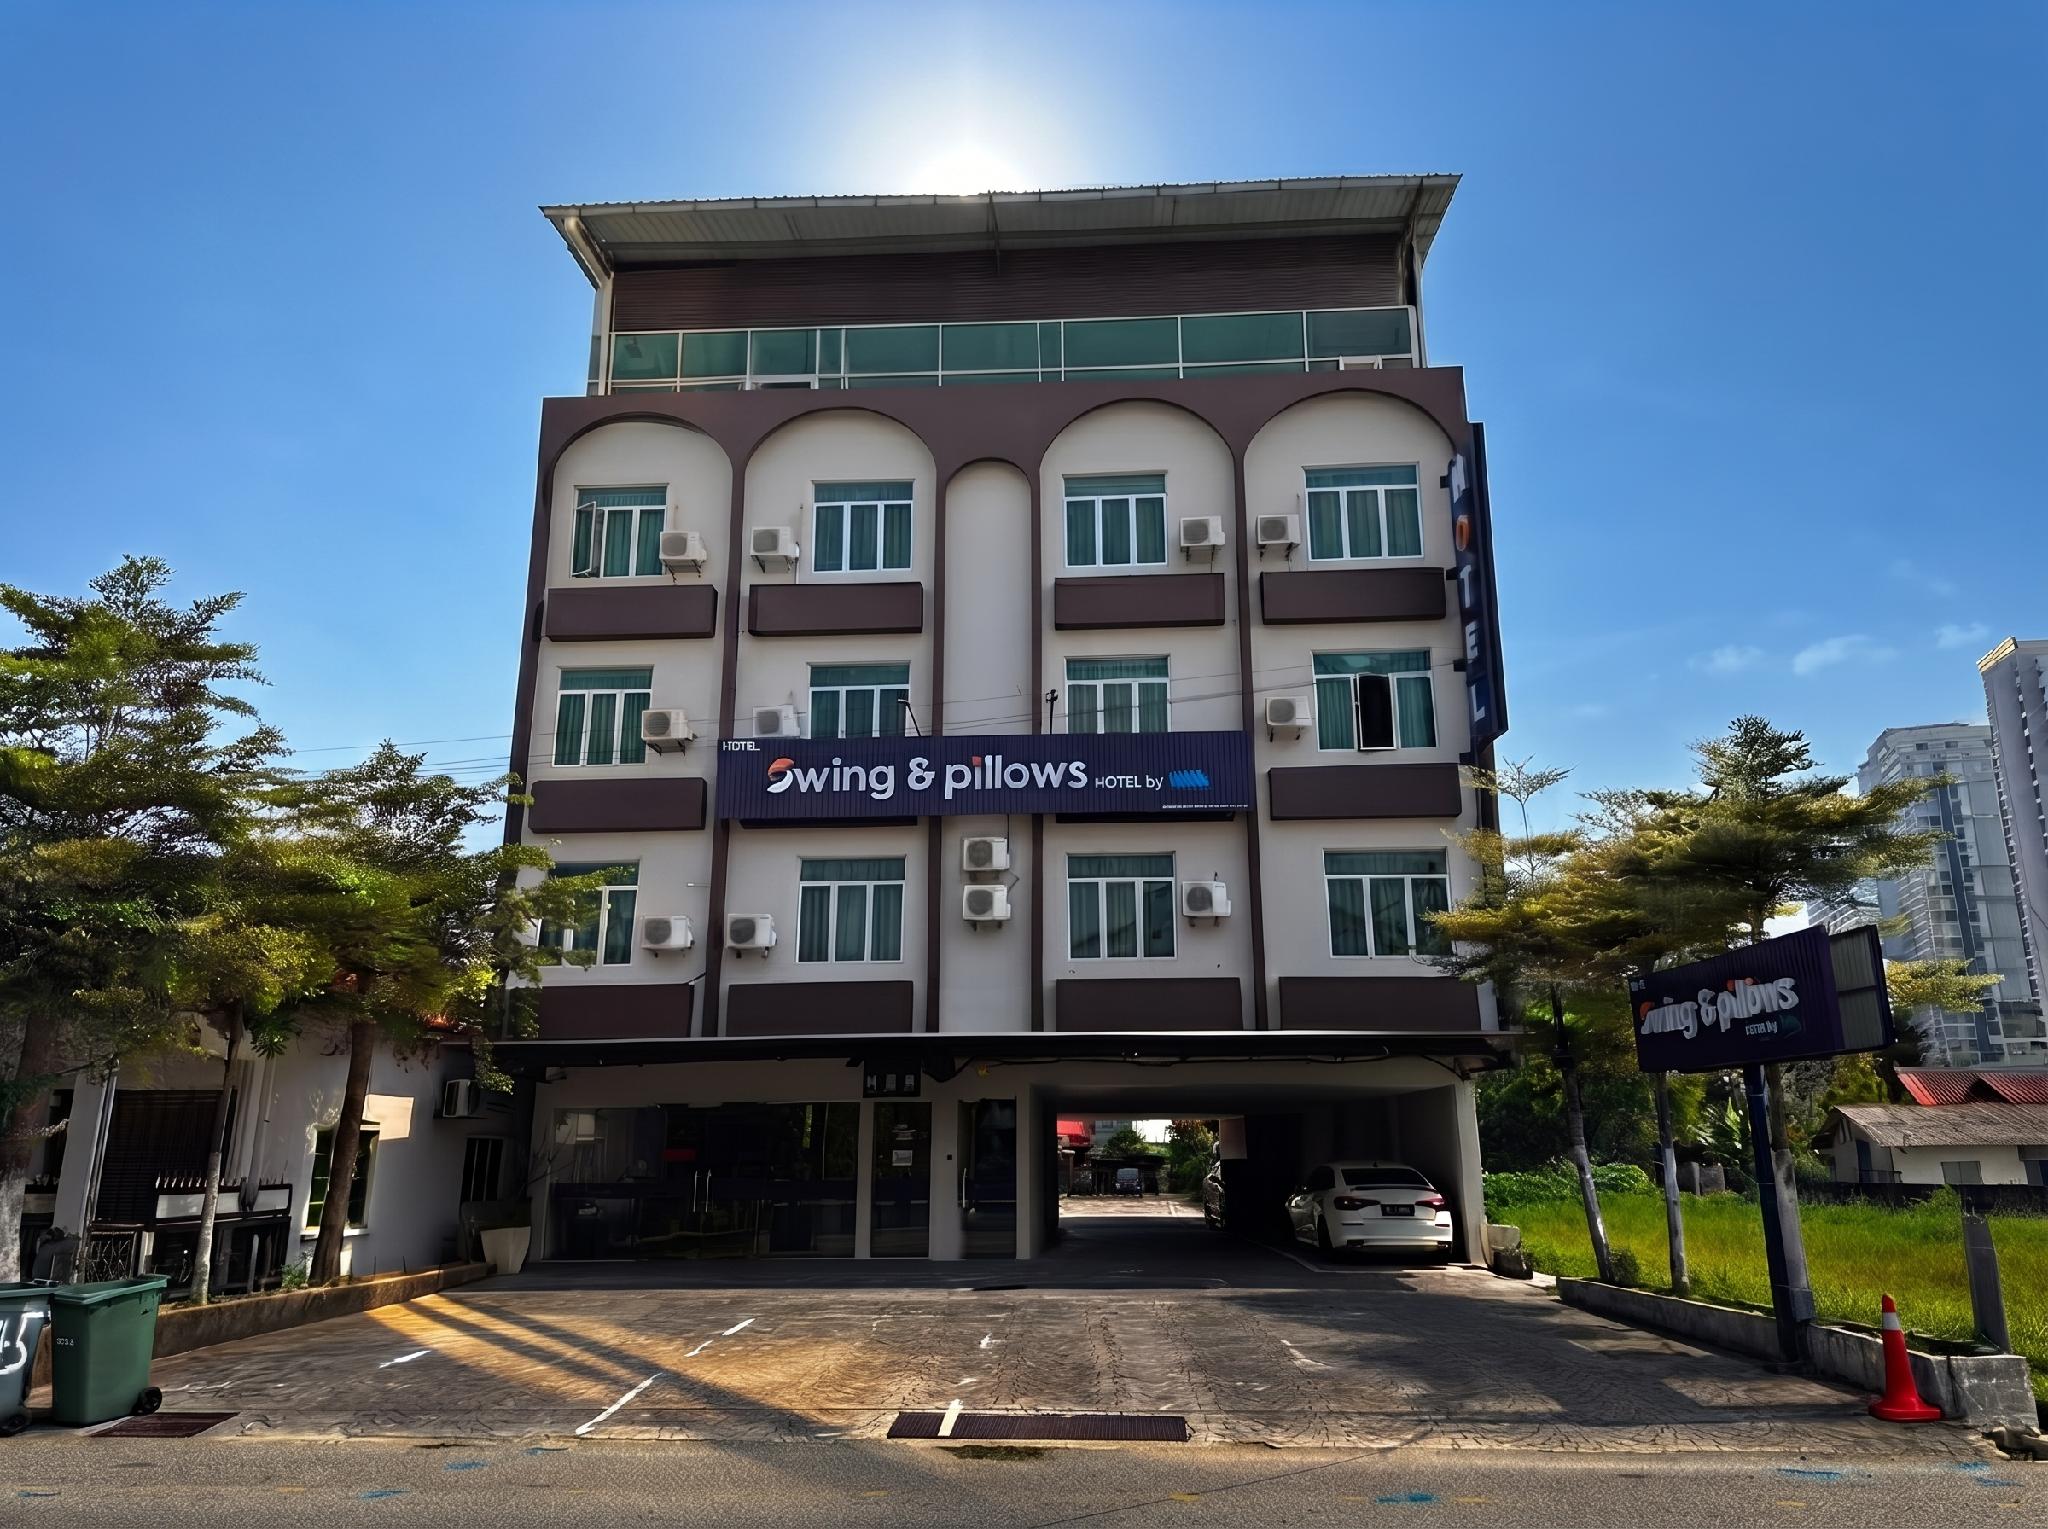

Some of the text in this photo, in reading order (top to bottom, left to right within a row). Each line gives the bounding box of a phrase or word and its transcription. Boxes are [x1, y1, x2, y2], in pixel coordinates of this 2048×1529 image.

[907, 757, 935, 791] &
[944, 755, 1088, 800] pillows
[1095, 775, 1142, 789] HOTEL
[1145, 774, 1163, 791] by
